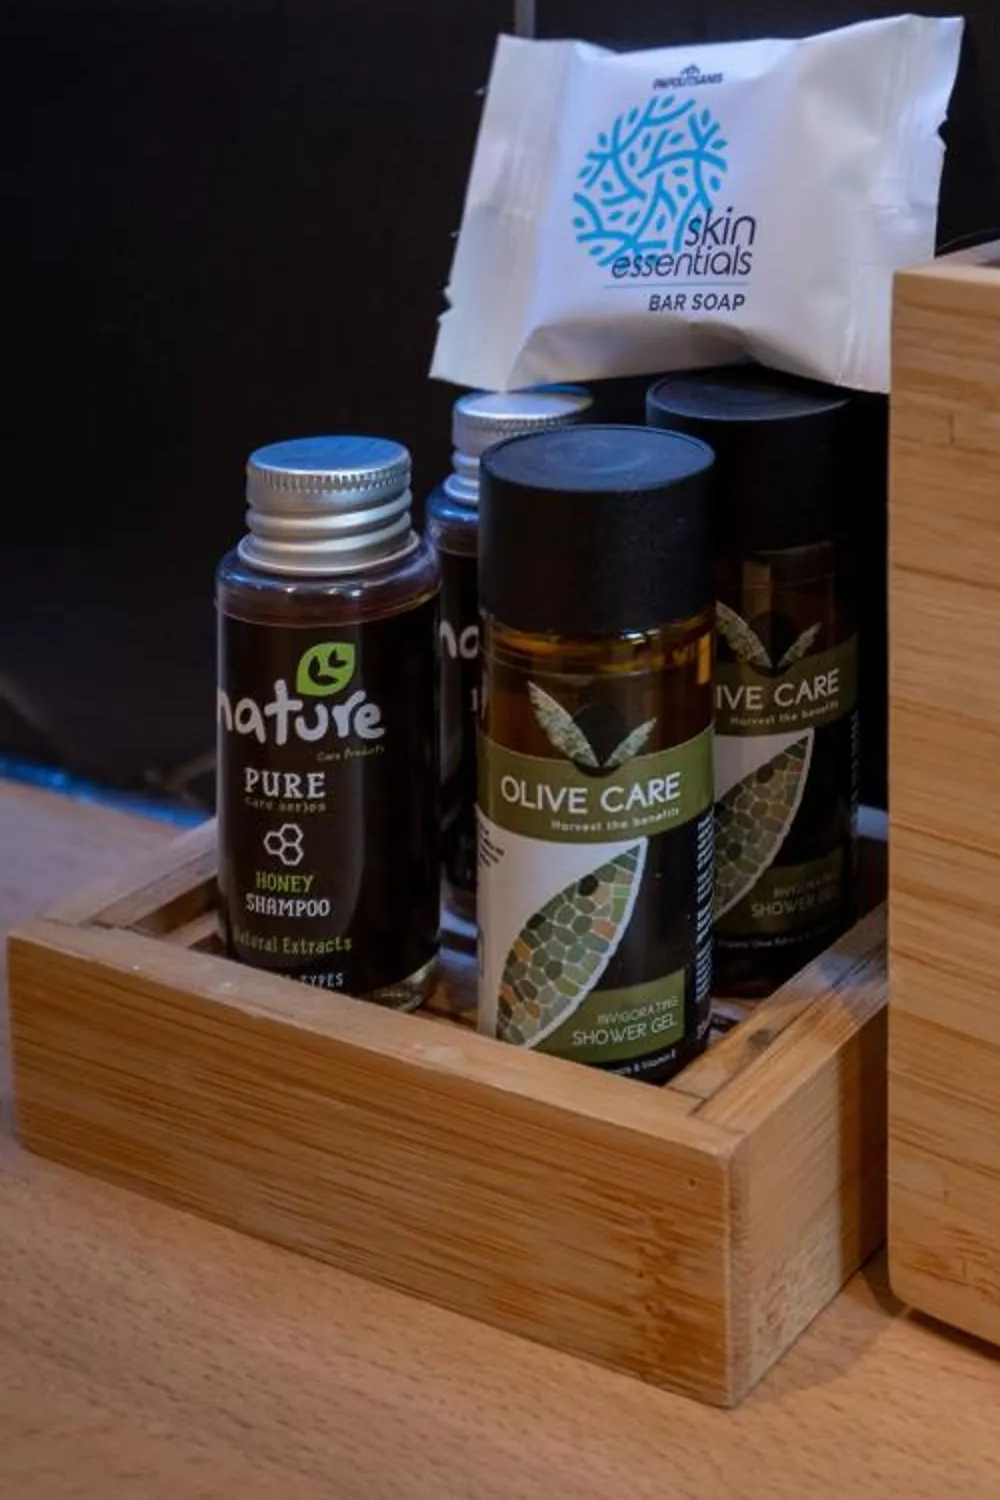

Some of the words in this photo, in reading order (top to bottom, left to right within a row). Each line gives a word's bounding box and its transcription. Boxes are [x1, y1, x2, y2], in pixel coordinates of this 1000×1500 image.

[684, 206, 756, 248] skin
[611, 244, 753, 279] essentials
[649, 294, 685, 312] BAR
[691, 293, 746, 312] SOAP
[716, 683, 764, 712] IVE
[773, 667, 841, 708] CARE
[217, 678, 387, 746] nature
[244, 766, 327, 799] PURE
[500, 775, 588, 815] OLIVE
[600, 771, 682, 815] CARE
[550, 819, 602, 834] Harvest
[606, 818, 629, 831] the
[255, 871, 314, 894] HONEY
[245, 893, 330, 918] SHAMPOO
[281, 936, 353, 955] Extracts
[597, 995, 680, 1026] INVIGORATING
[572, 1021, 647, 1047] SHOWER
[650, 1012, 678, 1034] GEL
